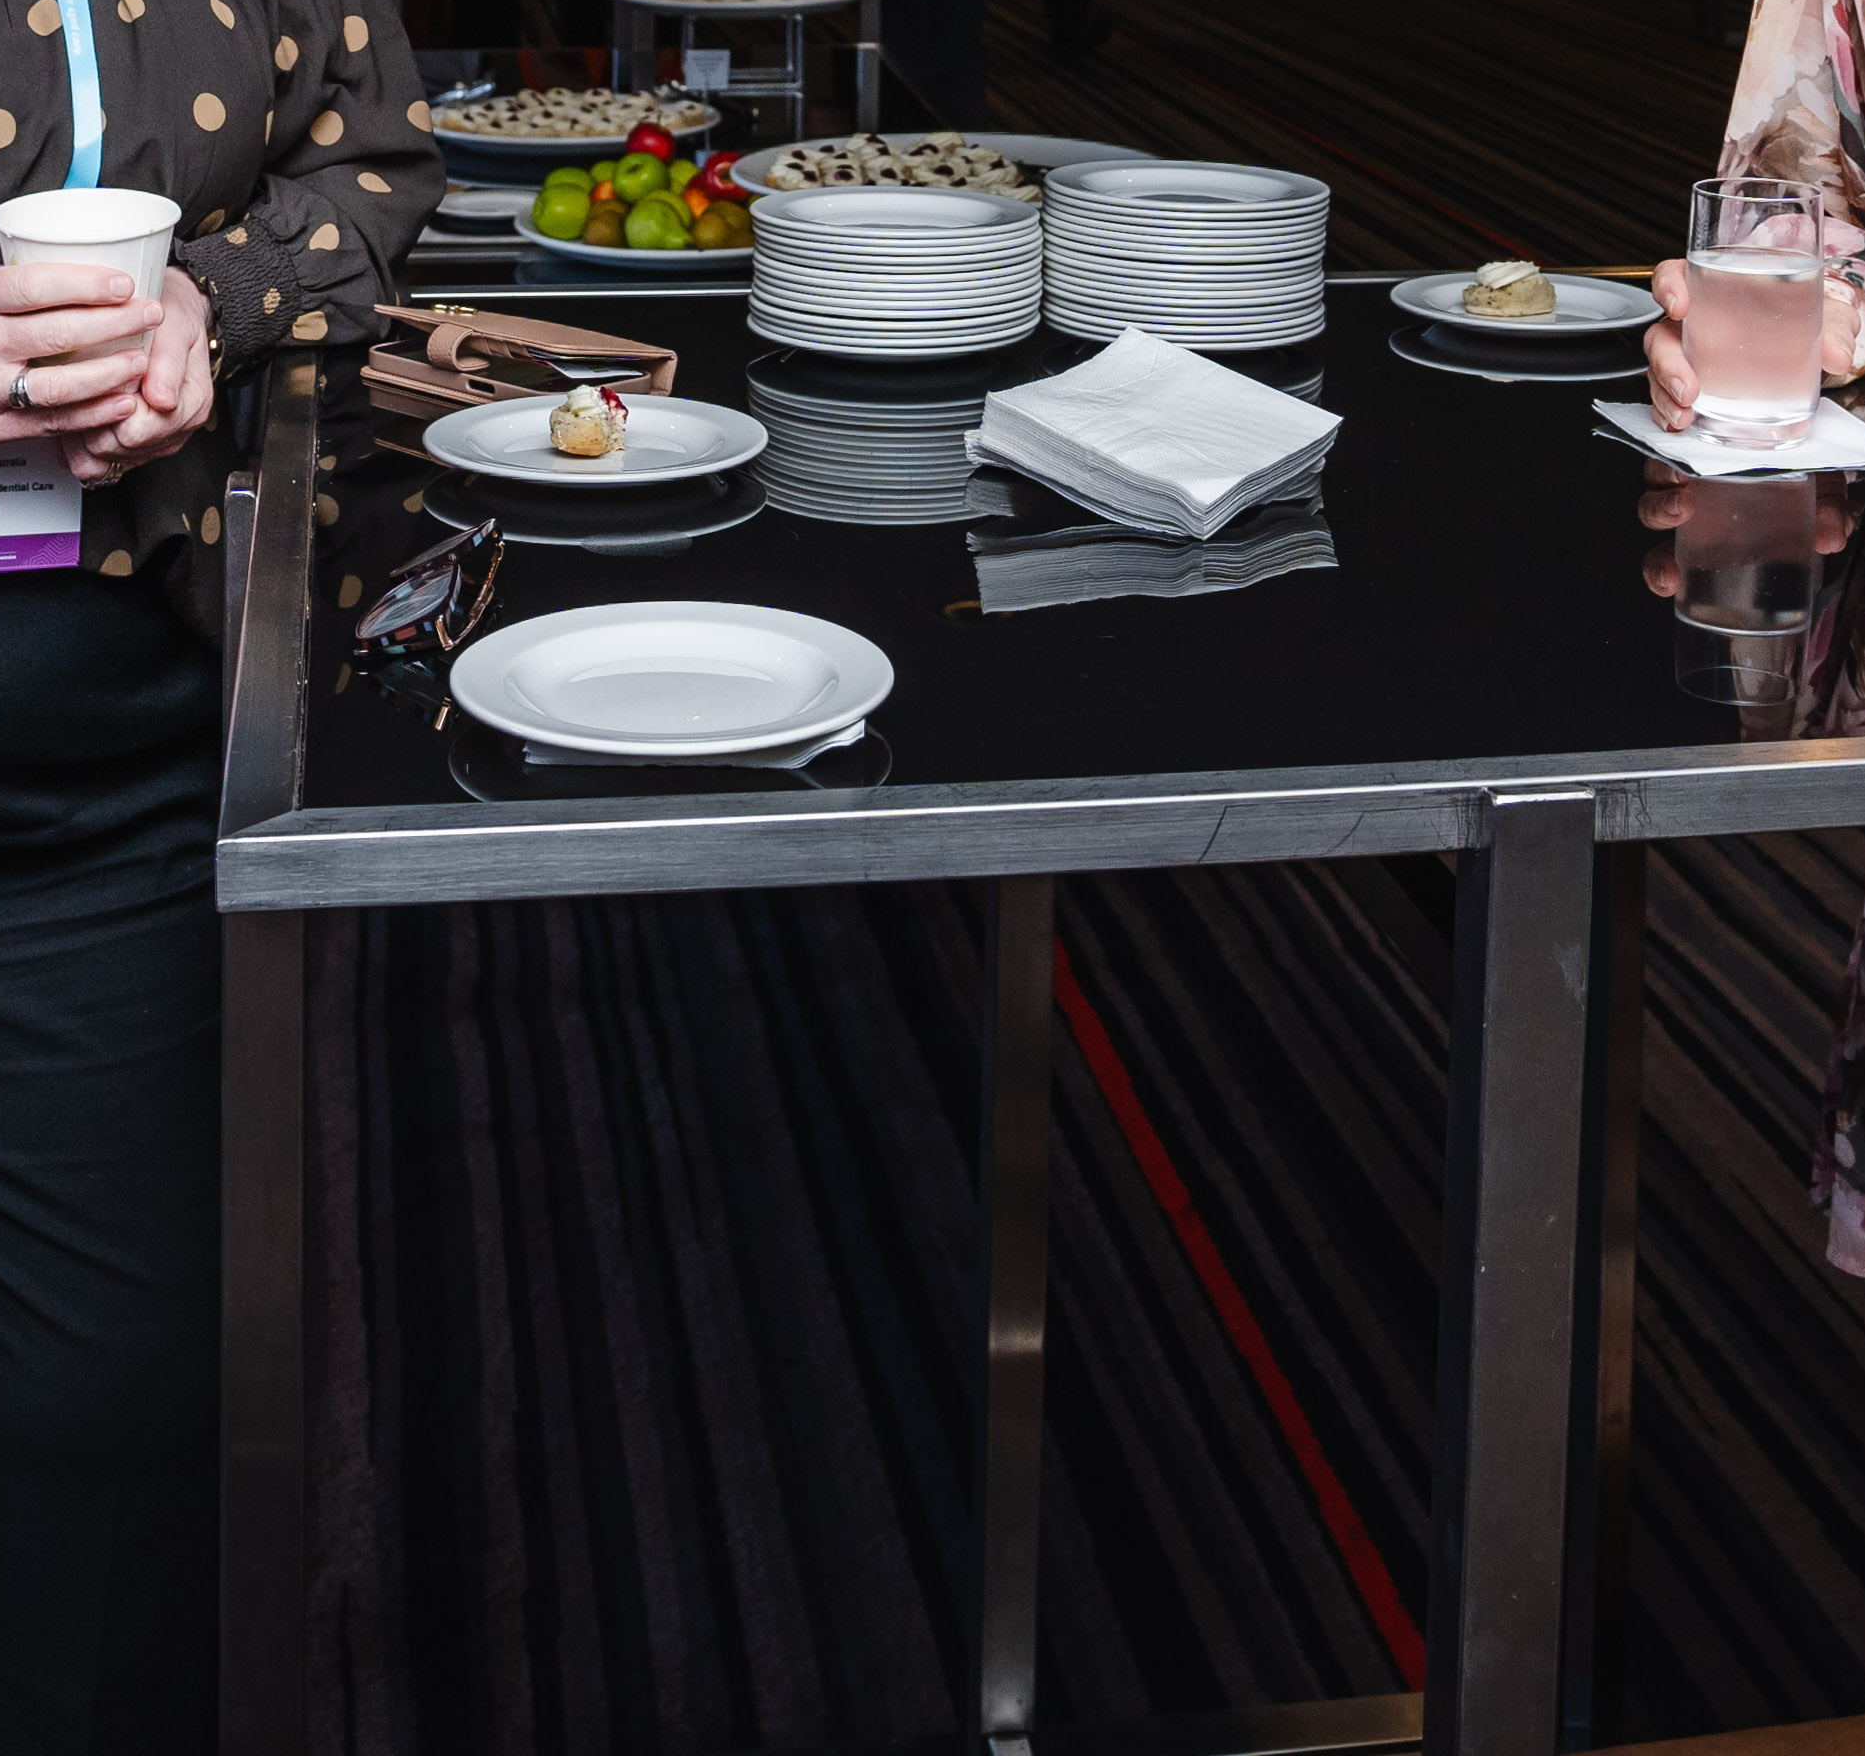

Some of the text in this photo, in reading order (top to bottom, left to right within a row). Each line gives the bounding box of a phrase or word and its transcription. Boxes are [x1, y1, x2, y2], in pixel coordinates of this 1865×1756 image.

[66, 6, 80, 31] aged
[71, 31, 81, 56] care
[32, 482, 54, 492] Care
